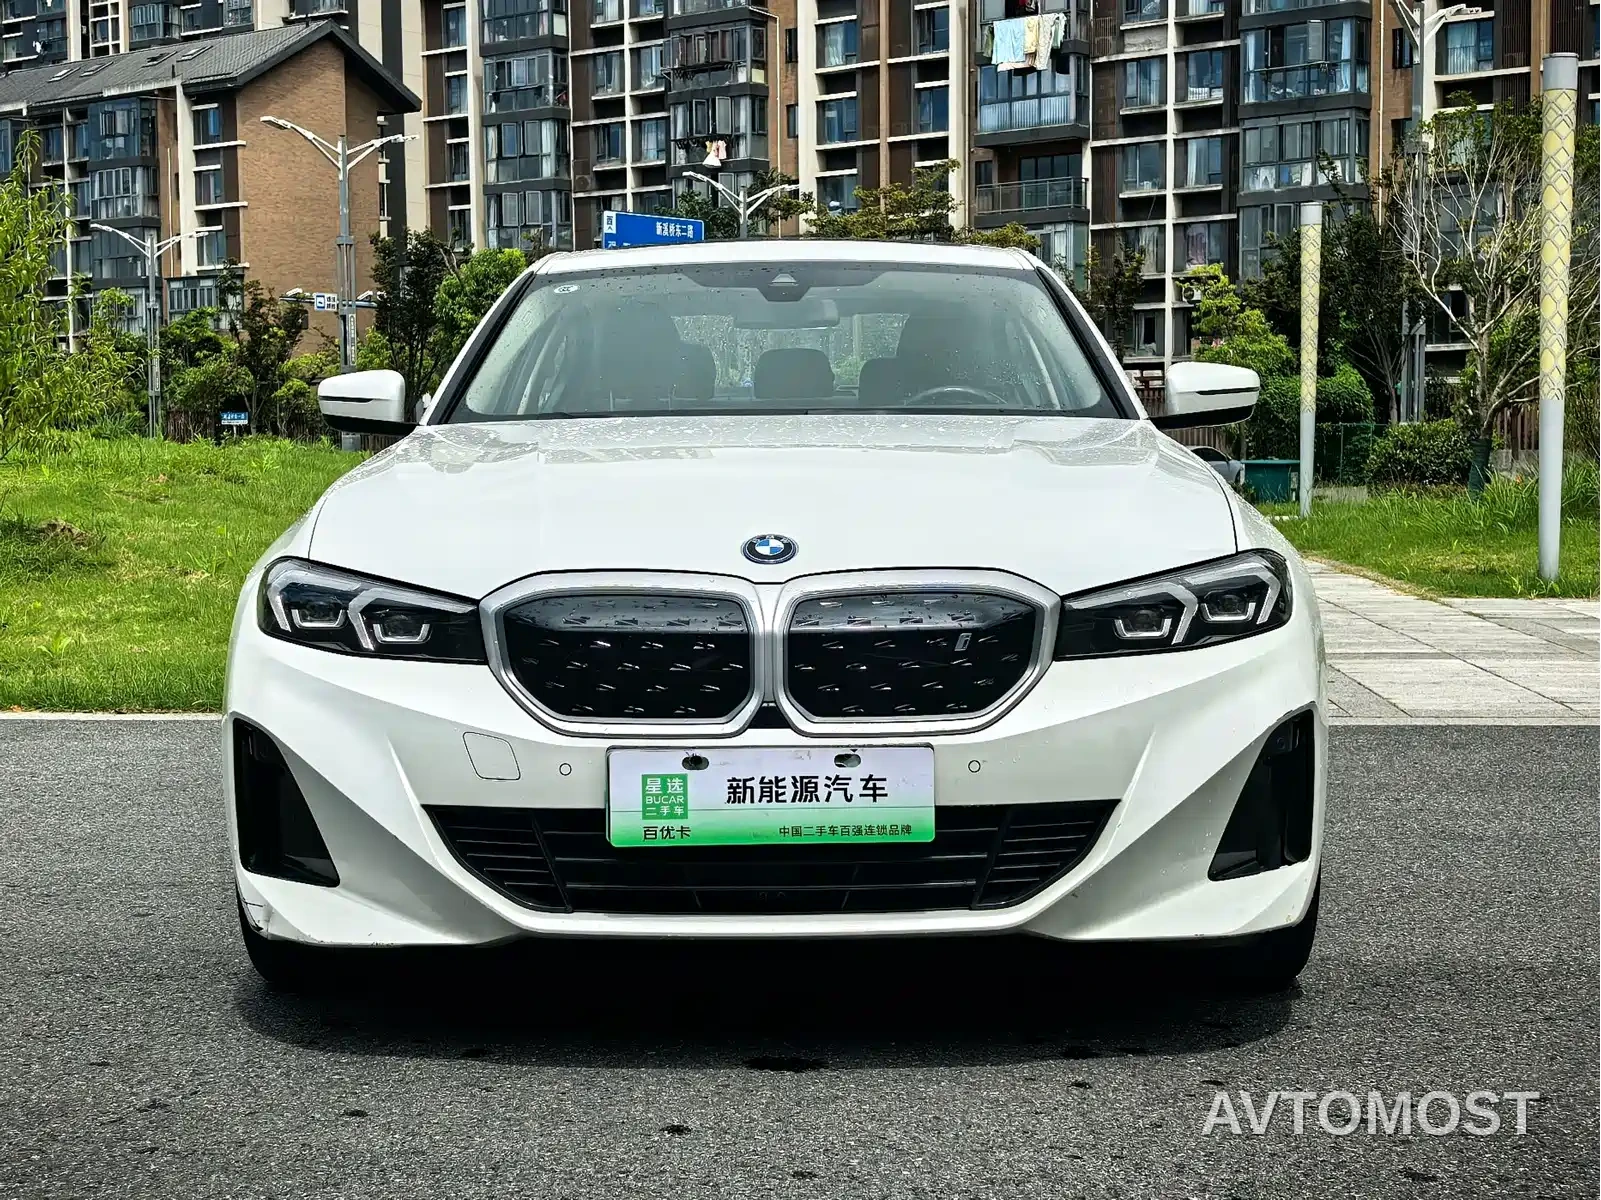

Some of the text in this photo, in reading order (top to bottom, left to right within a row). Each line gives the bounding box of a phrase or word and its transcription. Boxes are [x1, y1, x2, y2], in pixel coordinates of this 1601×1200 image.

[645, 777, 684, 794] 星选
[726, 774, 888, 804] 新能源汽车
[645, 796, 684, 804] BUCAR
[646, 806, 685, 816] 二手车
[643, 826, 691, 842] 百优卡
[779, 824, 912, 838] 中国二手车百强连锁品牌
